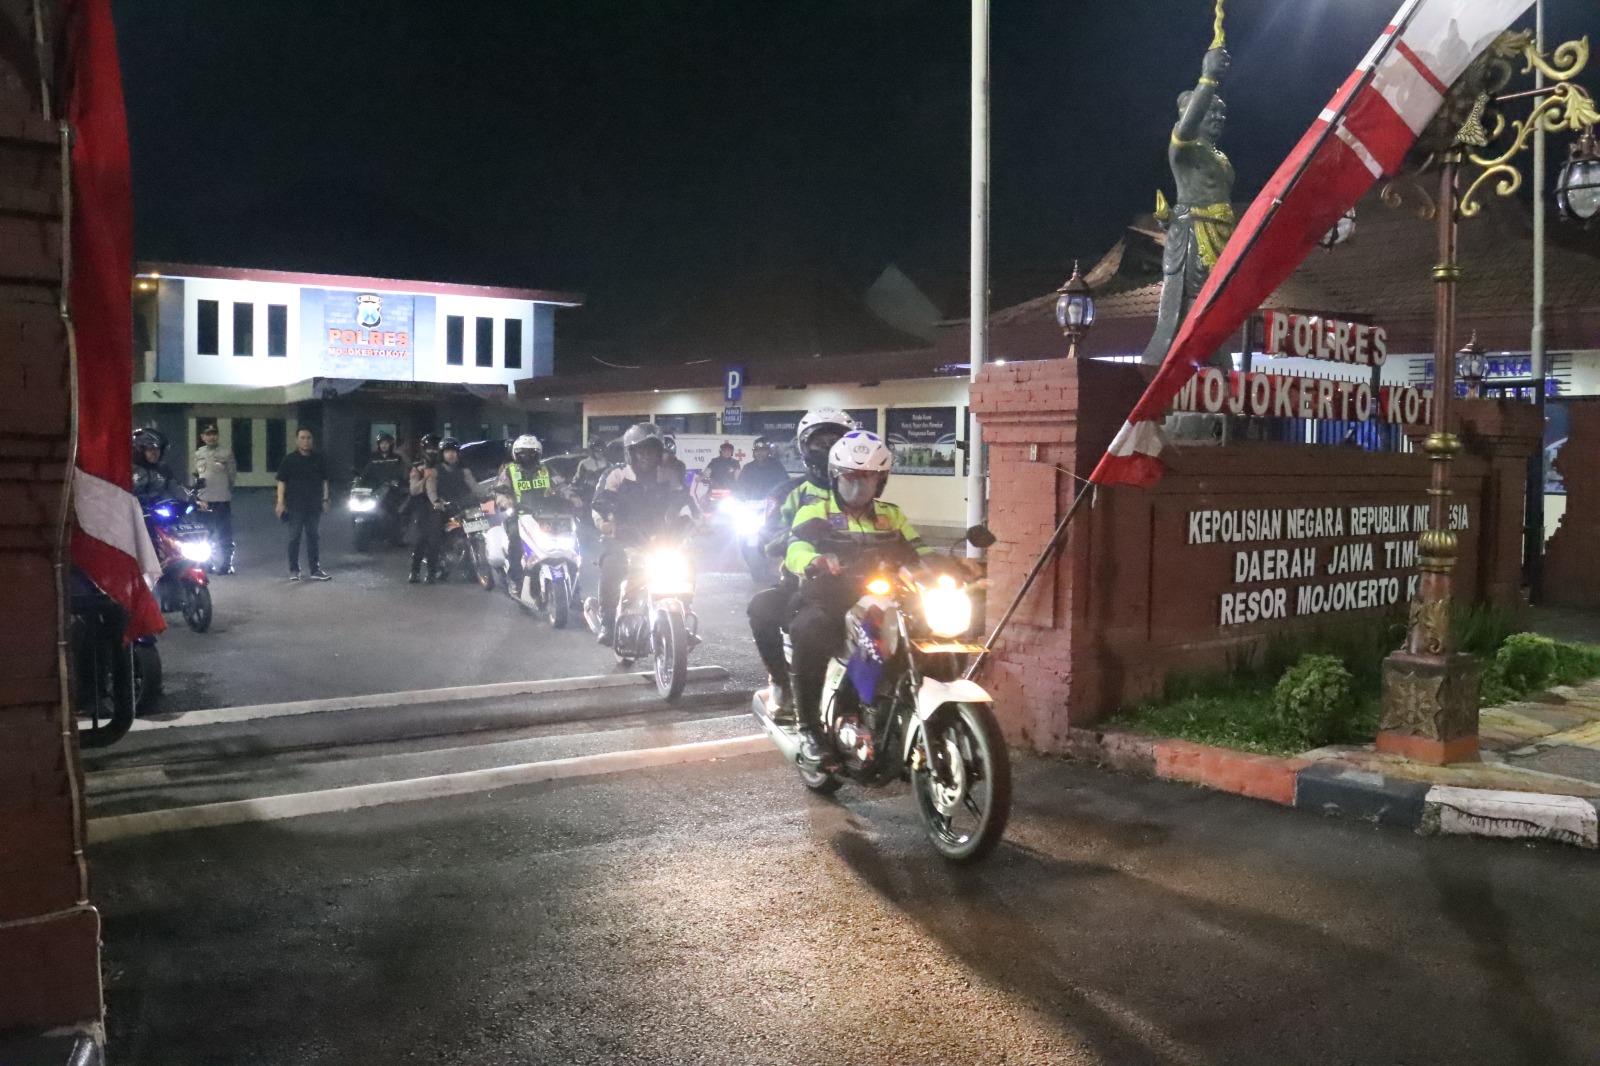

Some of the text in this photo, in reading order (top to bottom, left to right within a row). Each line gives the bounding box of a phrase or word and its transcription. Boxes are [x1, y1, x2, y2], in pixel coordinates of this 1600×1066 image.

[329, 328, 409, 347] POLRES
[1271, 311, 1387, 367] POLRES
[728, 371, 740, 399] P
[1173, 367, 1371, 422] MOJOKERTO
[1387, 386, 1434, 425] KOT
[1188, 509, 1281, 544] KEPOLISIAN
[1287, 507, 1344, 539] NEGARA
[1351, 504, 1410, 536] REPUBLIK
[1235, 540, 1420, 583] DAERAH JAWA TIM
[1220, 587, 1287, 626] RESOR
[1297, 577, 1399, 616] MOJOKERTO
